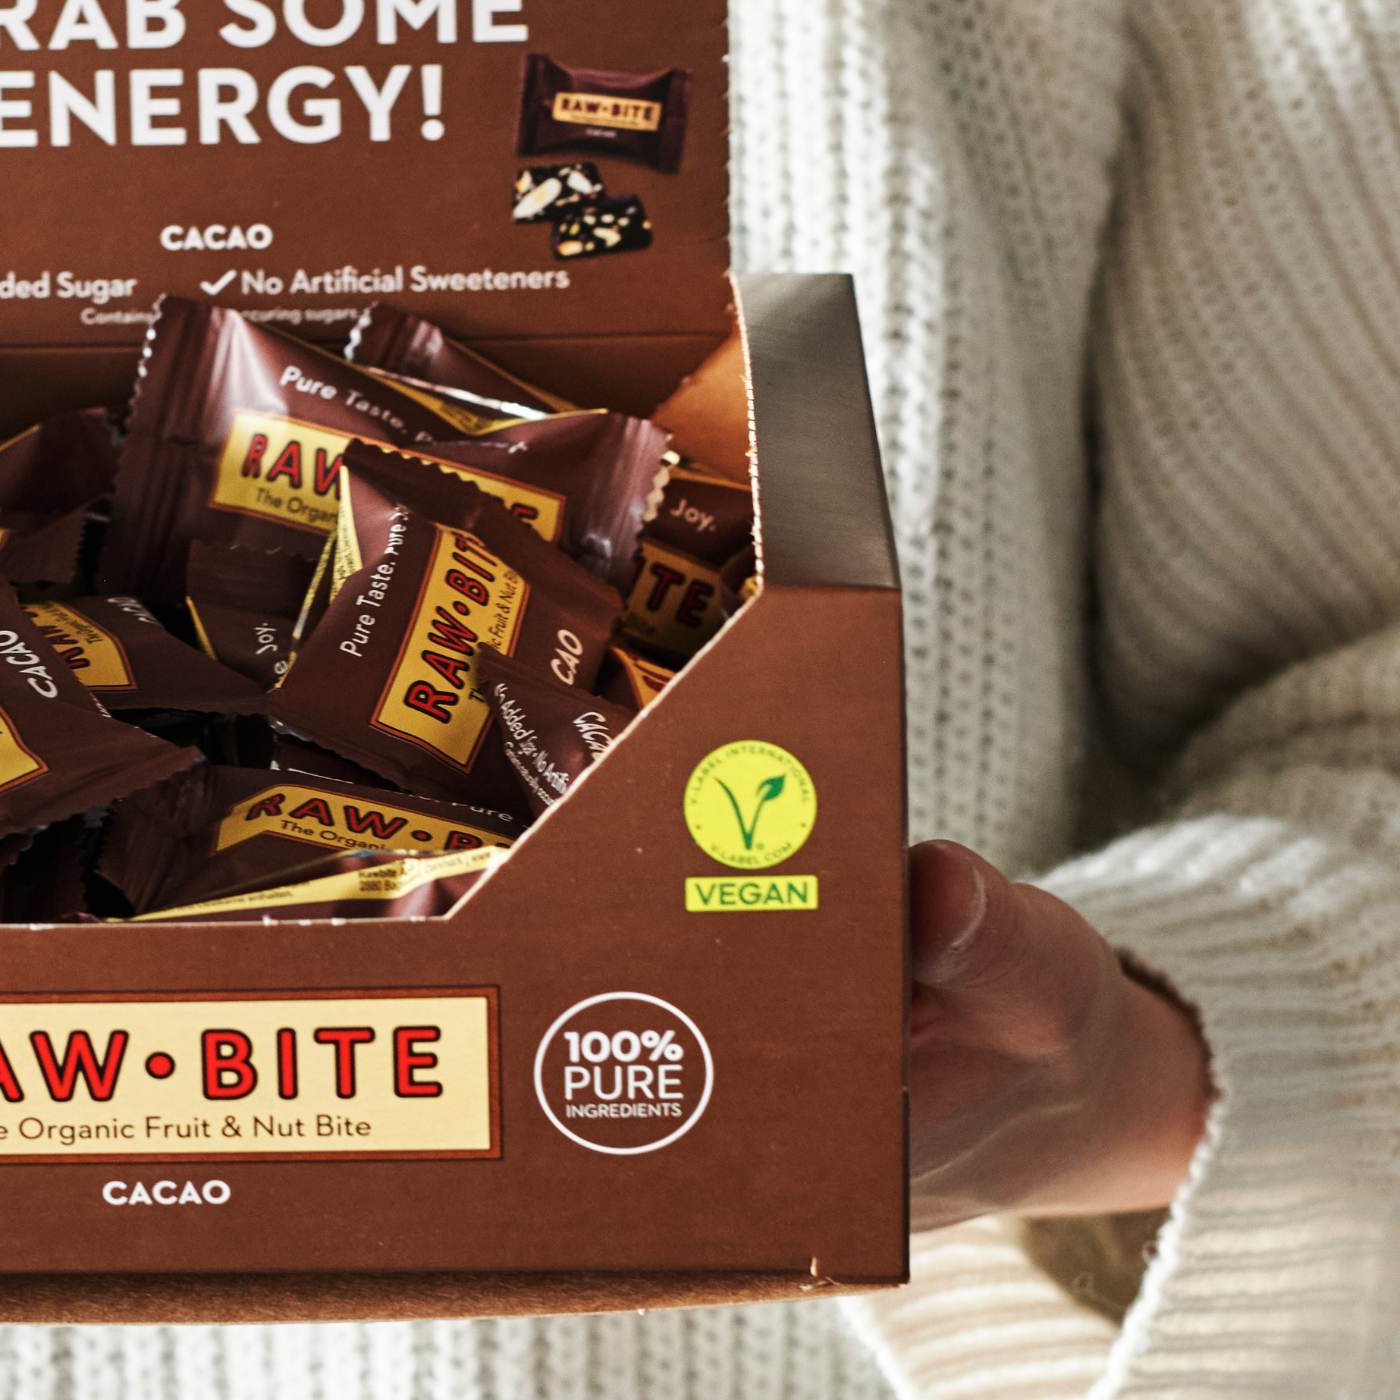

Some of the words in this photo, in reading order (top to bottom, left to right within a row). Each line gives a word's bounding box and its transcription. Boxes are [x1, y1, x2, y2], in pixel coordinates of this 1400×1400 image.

[219, 0, 530, 49] SOME
[160, 223, 274, 251] CACAO
[56, 270, 138, 304] Sugar
[241, 270, 283, 295] No
[290, 265, 403, 294] Artificial
[410, 265, 570, 291] Sweeteners
[279, 365, 338, 400] Pure
[345, 390, 409, 435] Taste.
[255, 486, 282, 509] The
[669, 498, 717, 533] Joy.
[355, 557, 397, 608] Taste.
[253, 622, 279, 656] Joy.
[339, 610, 377, 658] Pure
[551, 629, 584, 686] CAO
[499, 699, 536, 741] Added
[279, 818, 315, 837] The
[694, 881, 808, 906] VEGAN
[563, 1029, 685, 1063] 100%
[564, 1063, 684, 1101] PURE
[564, 1103, 683, 1120] INGREDIENTS
[18, 1115, 134, 1146] Organic
[144, 1113, 212, 1140] Fruit
[221, 1115, 243, 1138] &
[252, 1114, 306, 1138] Nut
[316, 1112, 372, 1138] Bite
[102, 1179, 232, 1207] CACAO
